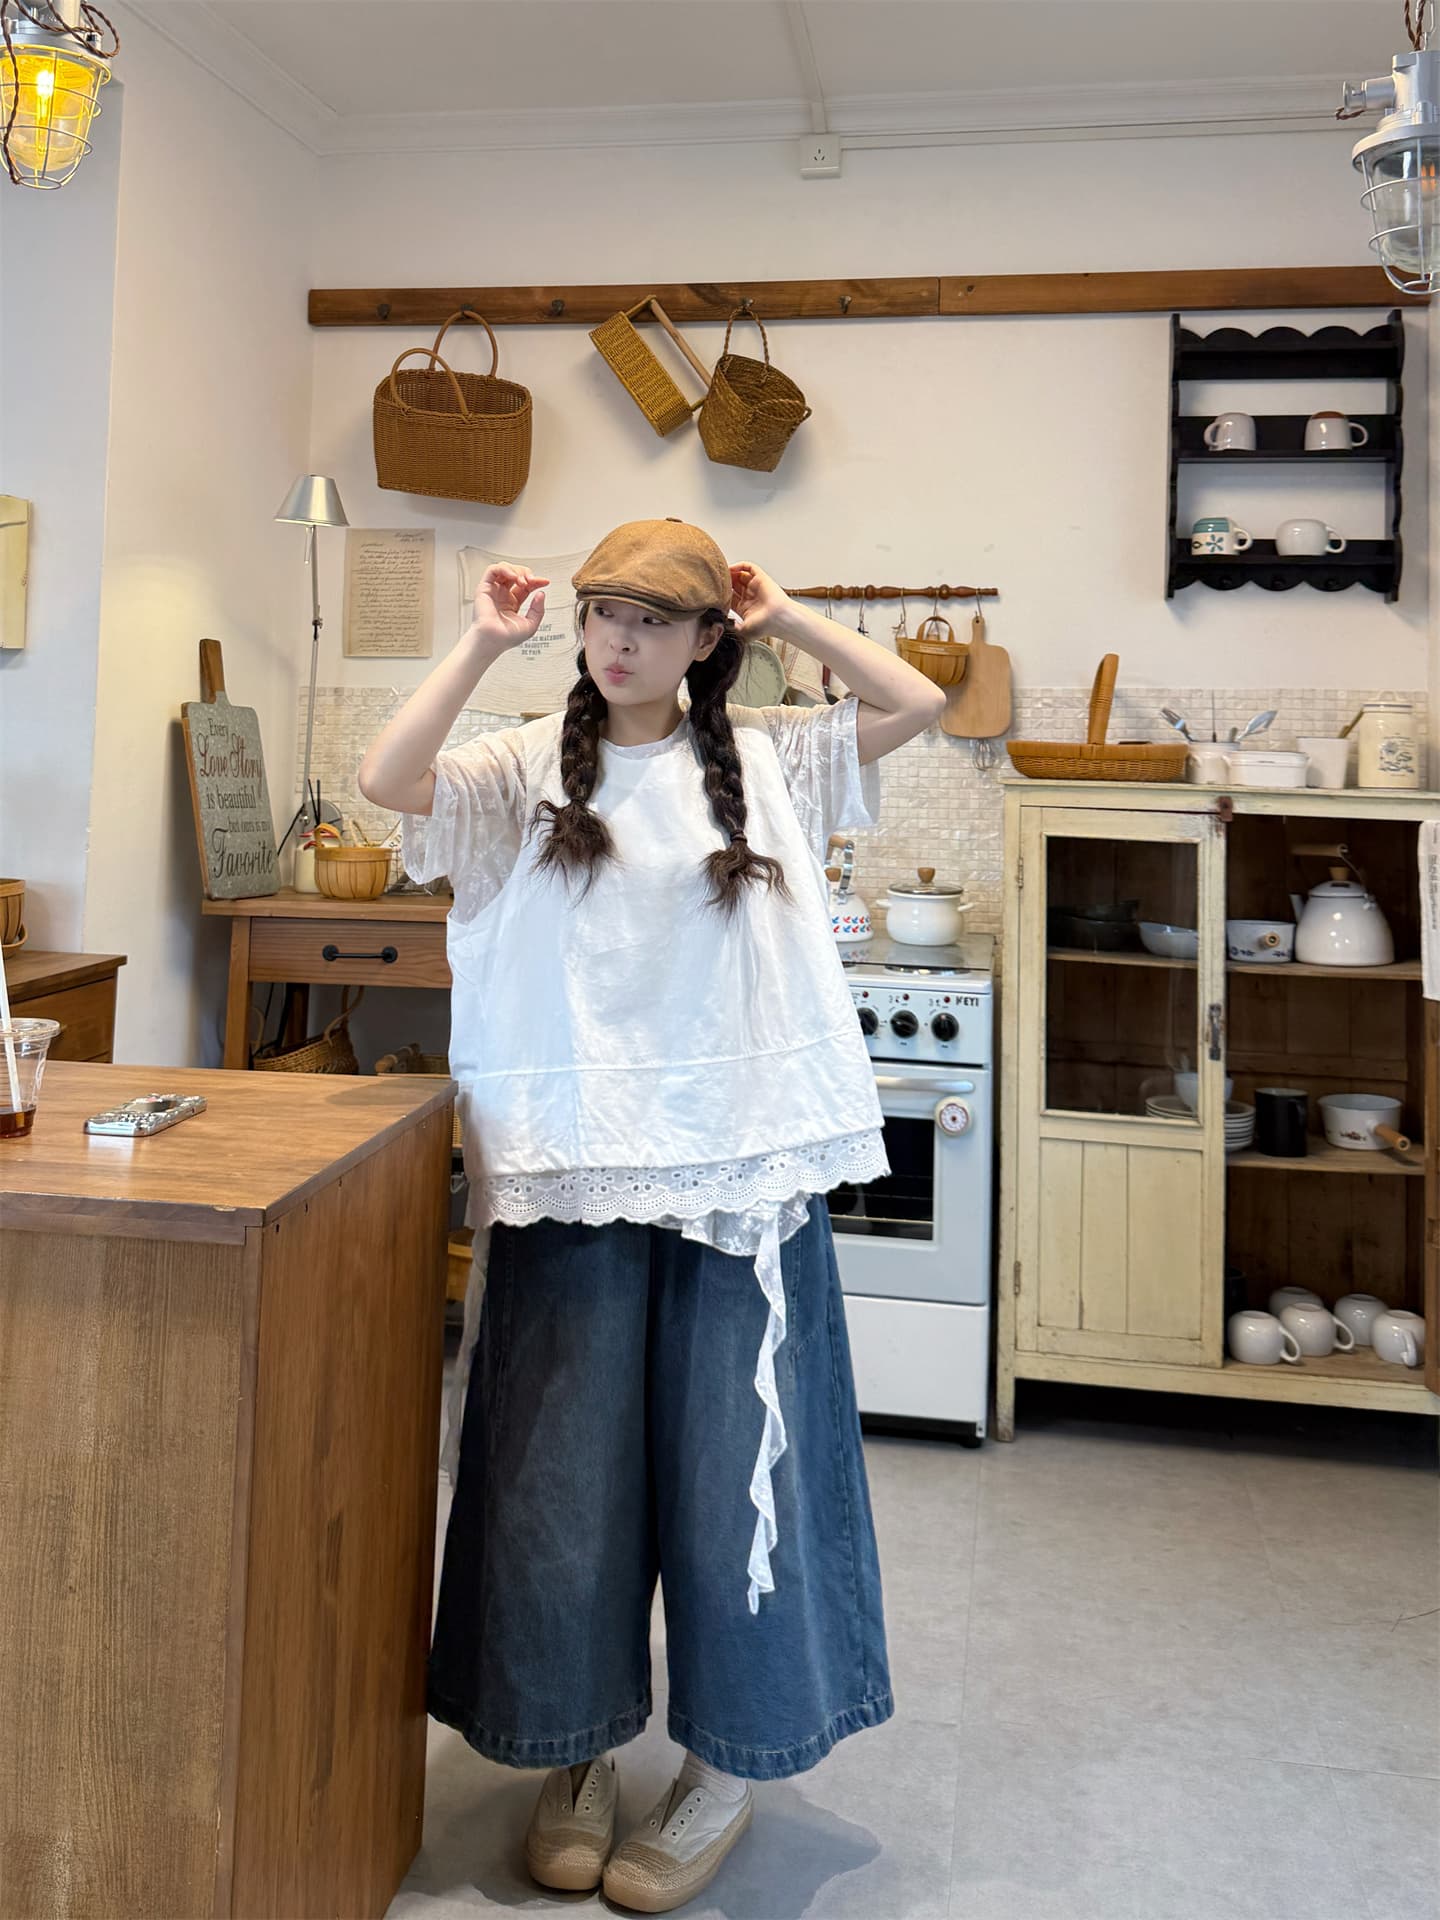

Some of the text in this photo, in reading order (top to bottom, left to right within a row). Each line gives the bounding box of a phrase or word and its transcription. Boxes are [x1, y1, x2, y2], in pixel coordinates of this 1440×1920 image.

[208, 718, 229, 741] Every
[197, 733, 263, 798] Love Story
[206, 785, 256, 809] is beautiful
[212, 828, 274, 878] Favorite
